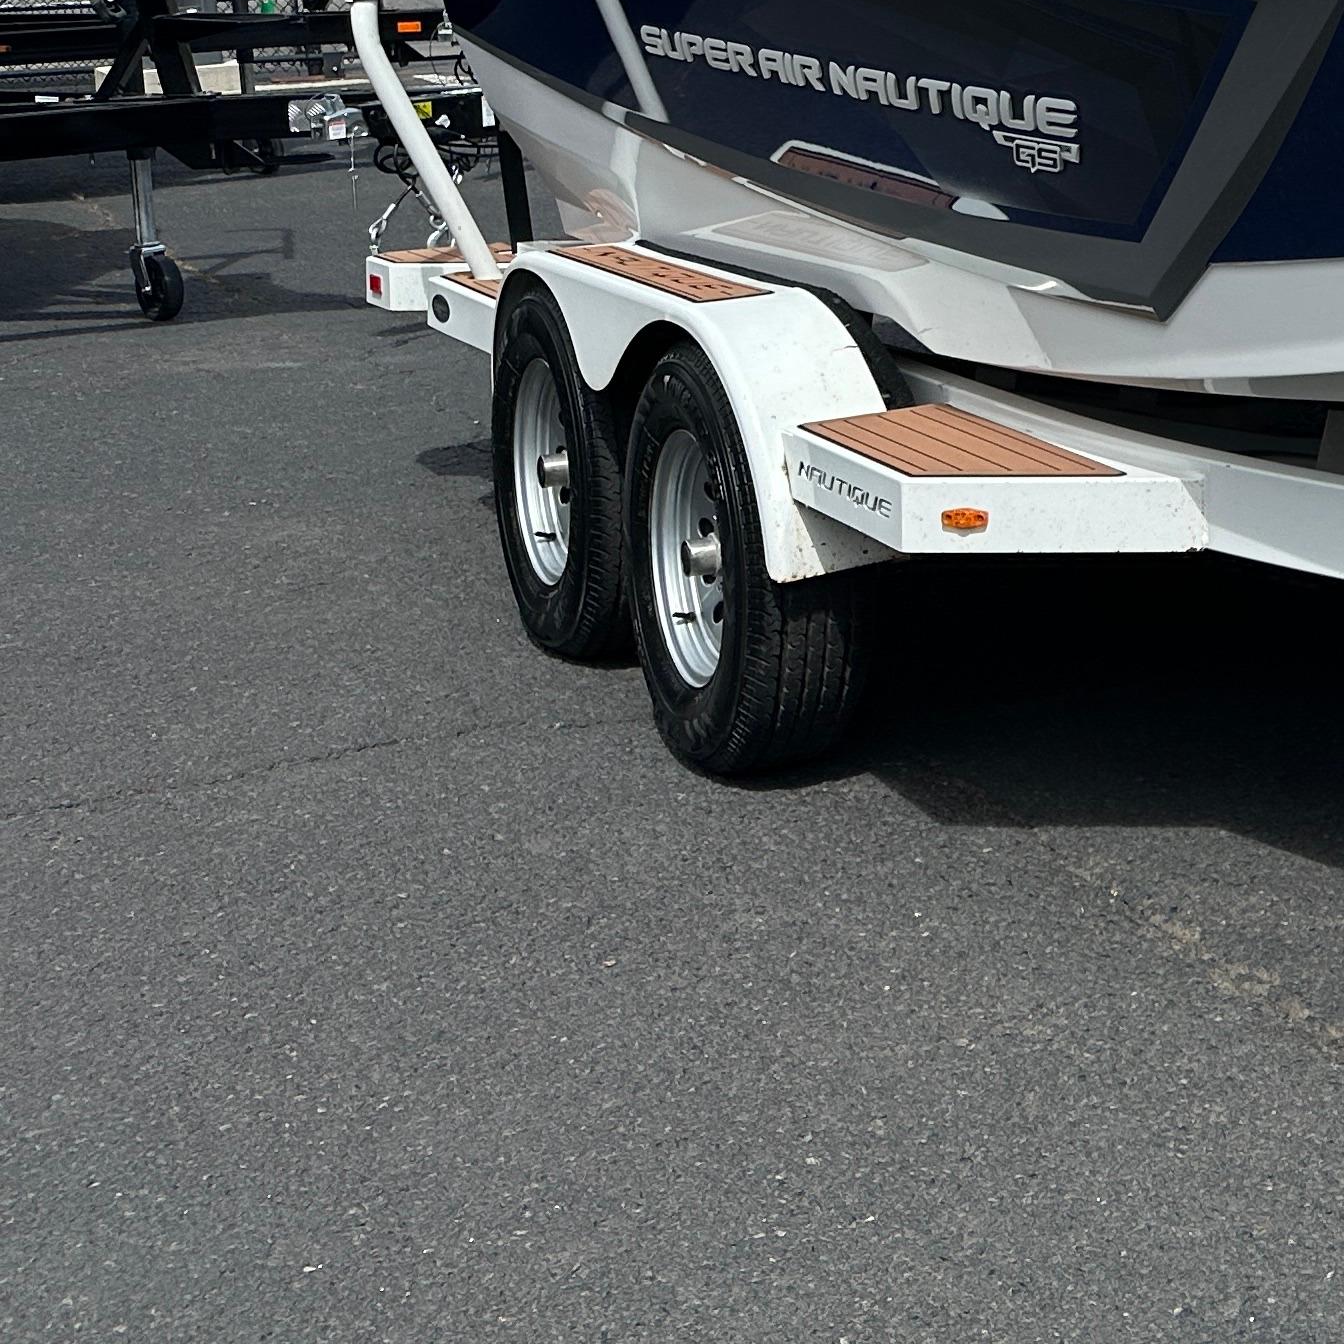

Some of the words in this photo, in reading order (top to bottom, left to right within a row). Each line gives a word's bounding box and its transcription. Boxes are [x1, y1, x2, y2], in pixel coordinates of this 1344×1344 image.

[640, 24, 759, 78] SUPER
[758, 47, 828, 93] AIR
[828, 60, 1079, 138] NAUTIQUE
[1012, 138, 1064, 174] GS
[797, 460, 893, 519] NAUTIQUE
